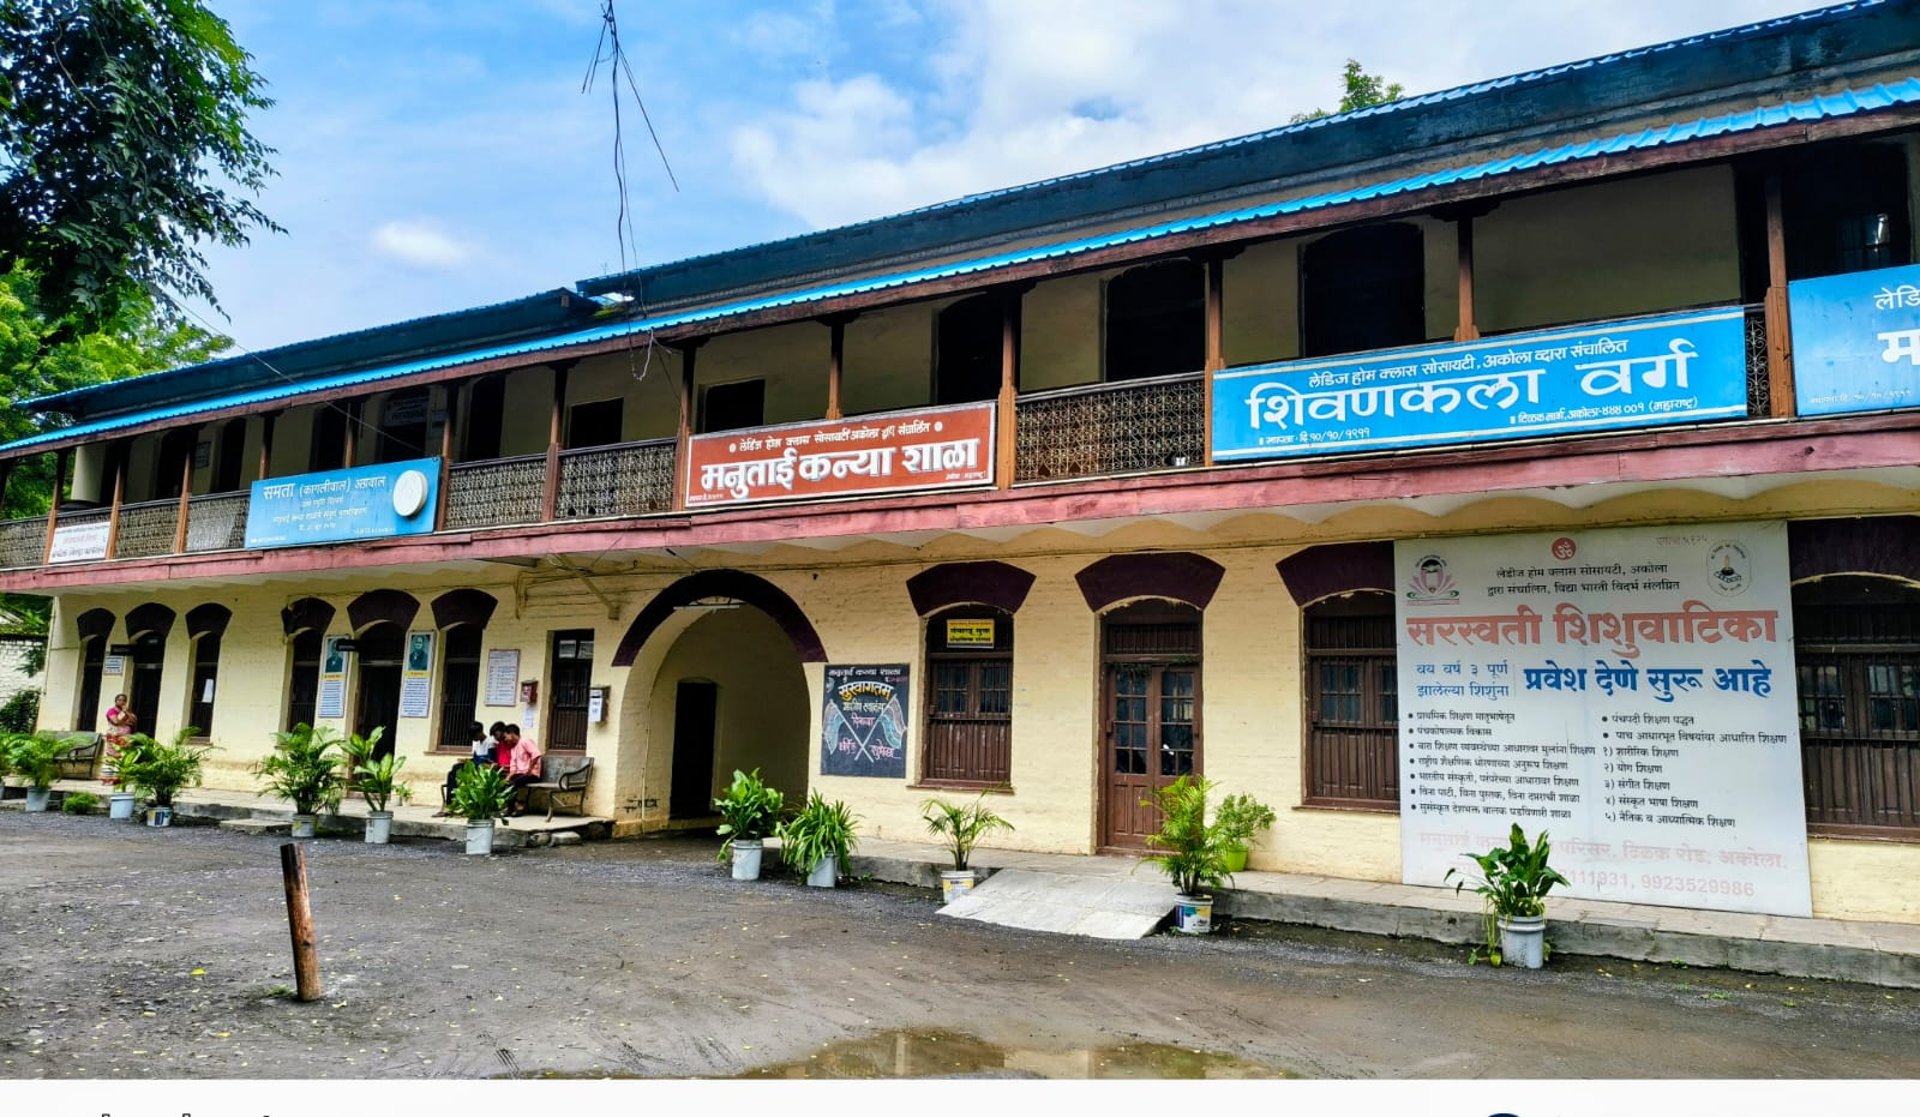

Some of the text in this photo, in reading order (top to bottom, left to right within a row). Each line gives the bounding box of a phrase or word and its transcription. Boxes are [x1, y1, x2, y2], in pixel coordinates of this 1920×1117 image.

[1309, 372, 1348, 388] लेडिज
[1352, 367, 1376, 385] होम
[1379, 365, 1418, 381] क्लास
[1484, 349, 1531, 369] अकोला
[1571, 337, 1629, 358] संचालित
[1245, 337, 1698, 430] शिवणकला वर्ग
[701, 438, 979, 498] मनुताई कन्या शाळा
[263, 482, 296, 500] समता
[1528, 565, 1544, 577] होम
[1631, 563, 1667, 575] अकोला
[1582, 580, 1607, 592] भारती
[1612, 578, 1638, 592] विदर्भ
[1406, 600, 1778, 658] सरस्वती शिशुवाटिका
[1417, 660, 1508, 677] वय वर्ष ३ पूर्ण
[1524, 659, 1772, 702] प्रवेश देणे सुरू आहे
[1417, 681, 1509, 701] झालेल्या शिशुंना
[1417, 711, 1447, 721] प्राथमिक
[1449, 710, 1473, 721] शिक्षण
[1643, 712, 1670, 724] शिक्षण
[1466, 725, 1492, 736] विकास
[1719, 731, 1755, 743] आधारित
[1758, 732, 1787, 744] शिक्षण
[1570, 744, 1595, 755] शिक्षण
[1652, 746, 1679, 757] शिक्षण
[1542, 760, 1568, 770] शिक्षण
[1617, 761, 1633, 772] योग
[1636, 761, 1662, 773] शिक्षण
[1419, 771, 1445, 781] भारतीय
[1553, 776, 1579, 786] शिक्षण
[1618, 777, 1640, 789] संगीत
[1643, 778, 1670, 790] शिक्षण
[1618, 793, 1645, 808] संस्कृत
[1648, 797, 1668, 807] भाषा
[1671, 797, 1698, 808] शिक्षण
[1707, 814, 1736, 827] शिक्षण
